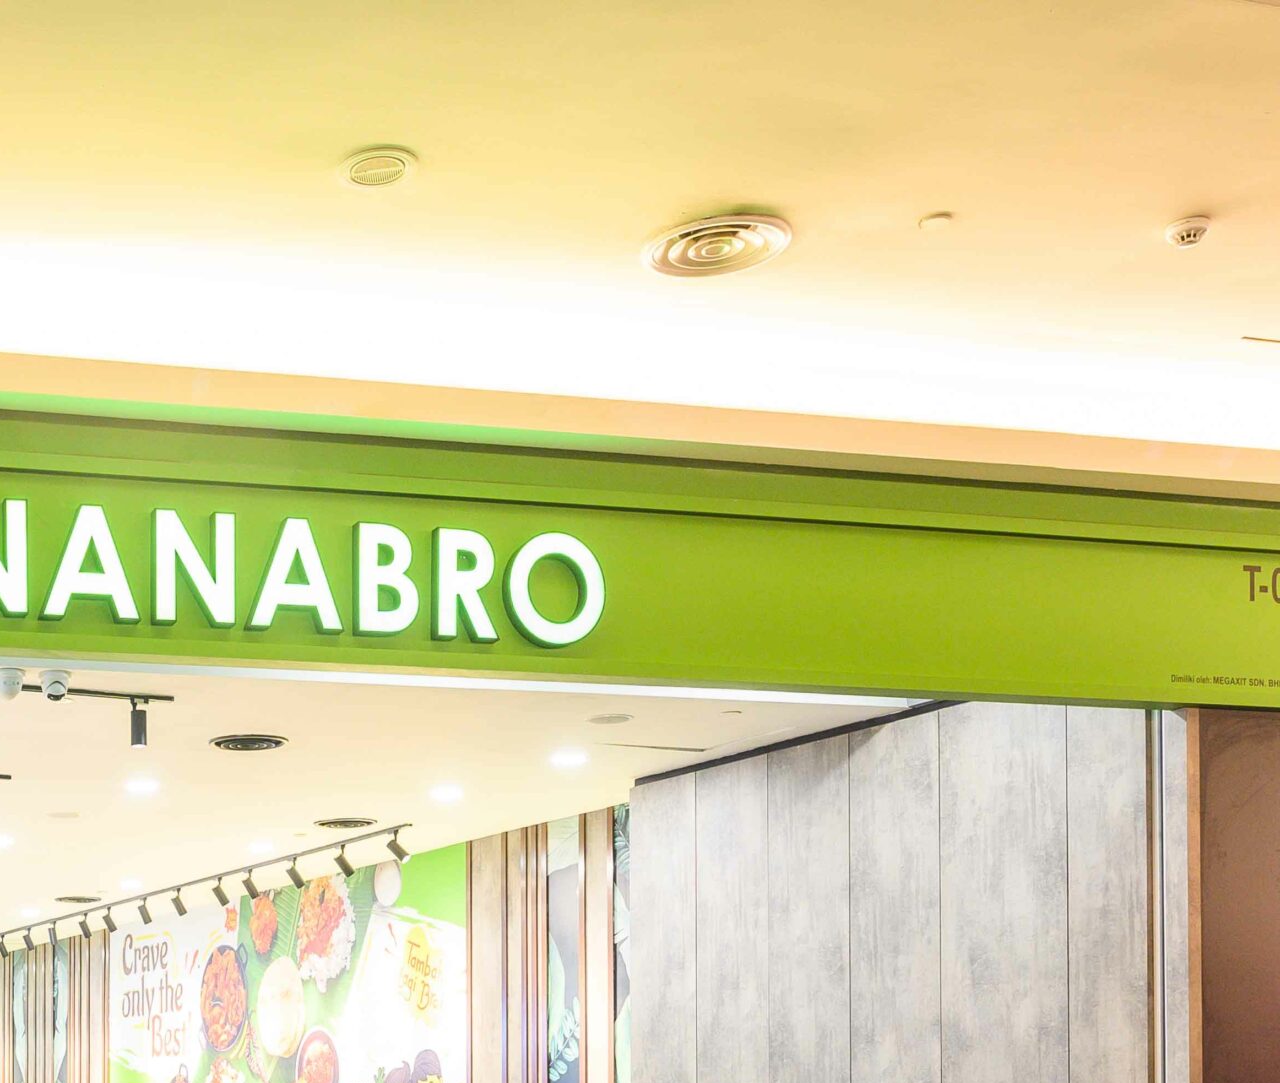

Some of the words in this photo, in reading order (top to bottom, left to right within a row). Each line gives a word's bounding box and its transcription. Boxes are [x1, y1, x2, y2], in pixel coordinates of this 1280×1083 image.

[1171, 674, 1195, 684] Dimiliki
[1213, 676, 1247, 686] MEGAXIT
[1268, 679, 1280, 688] BH
[122, 933, 168, 976] Crave
[121, 974, 155, 1031] only
[159, 970, 184, 1014] the
